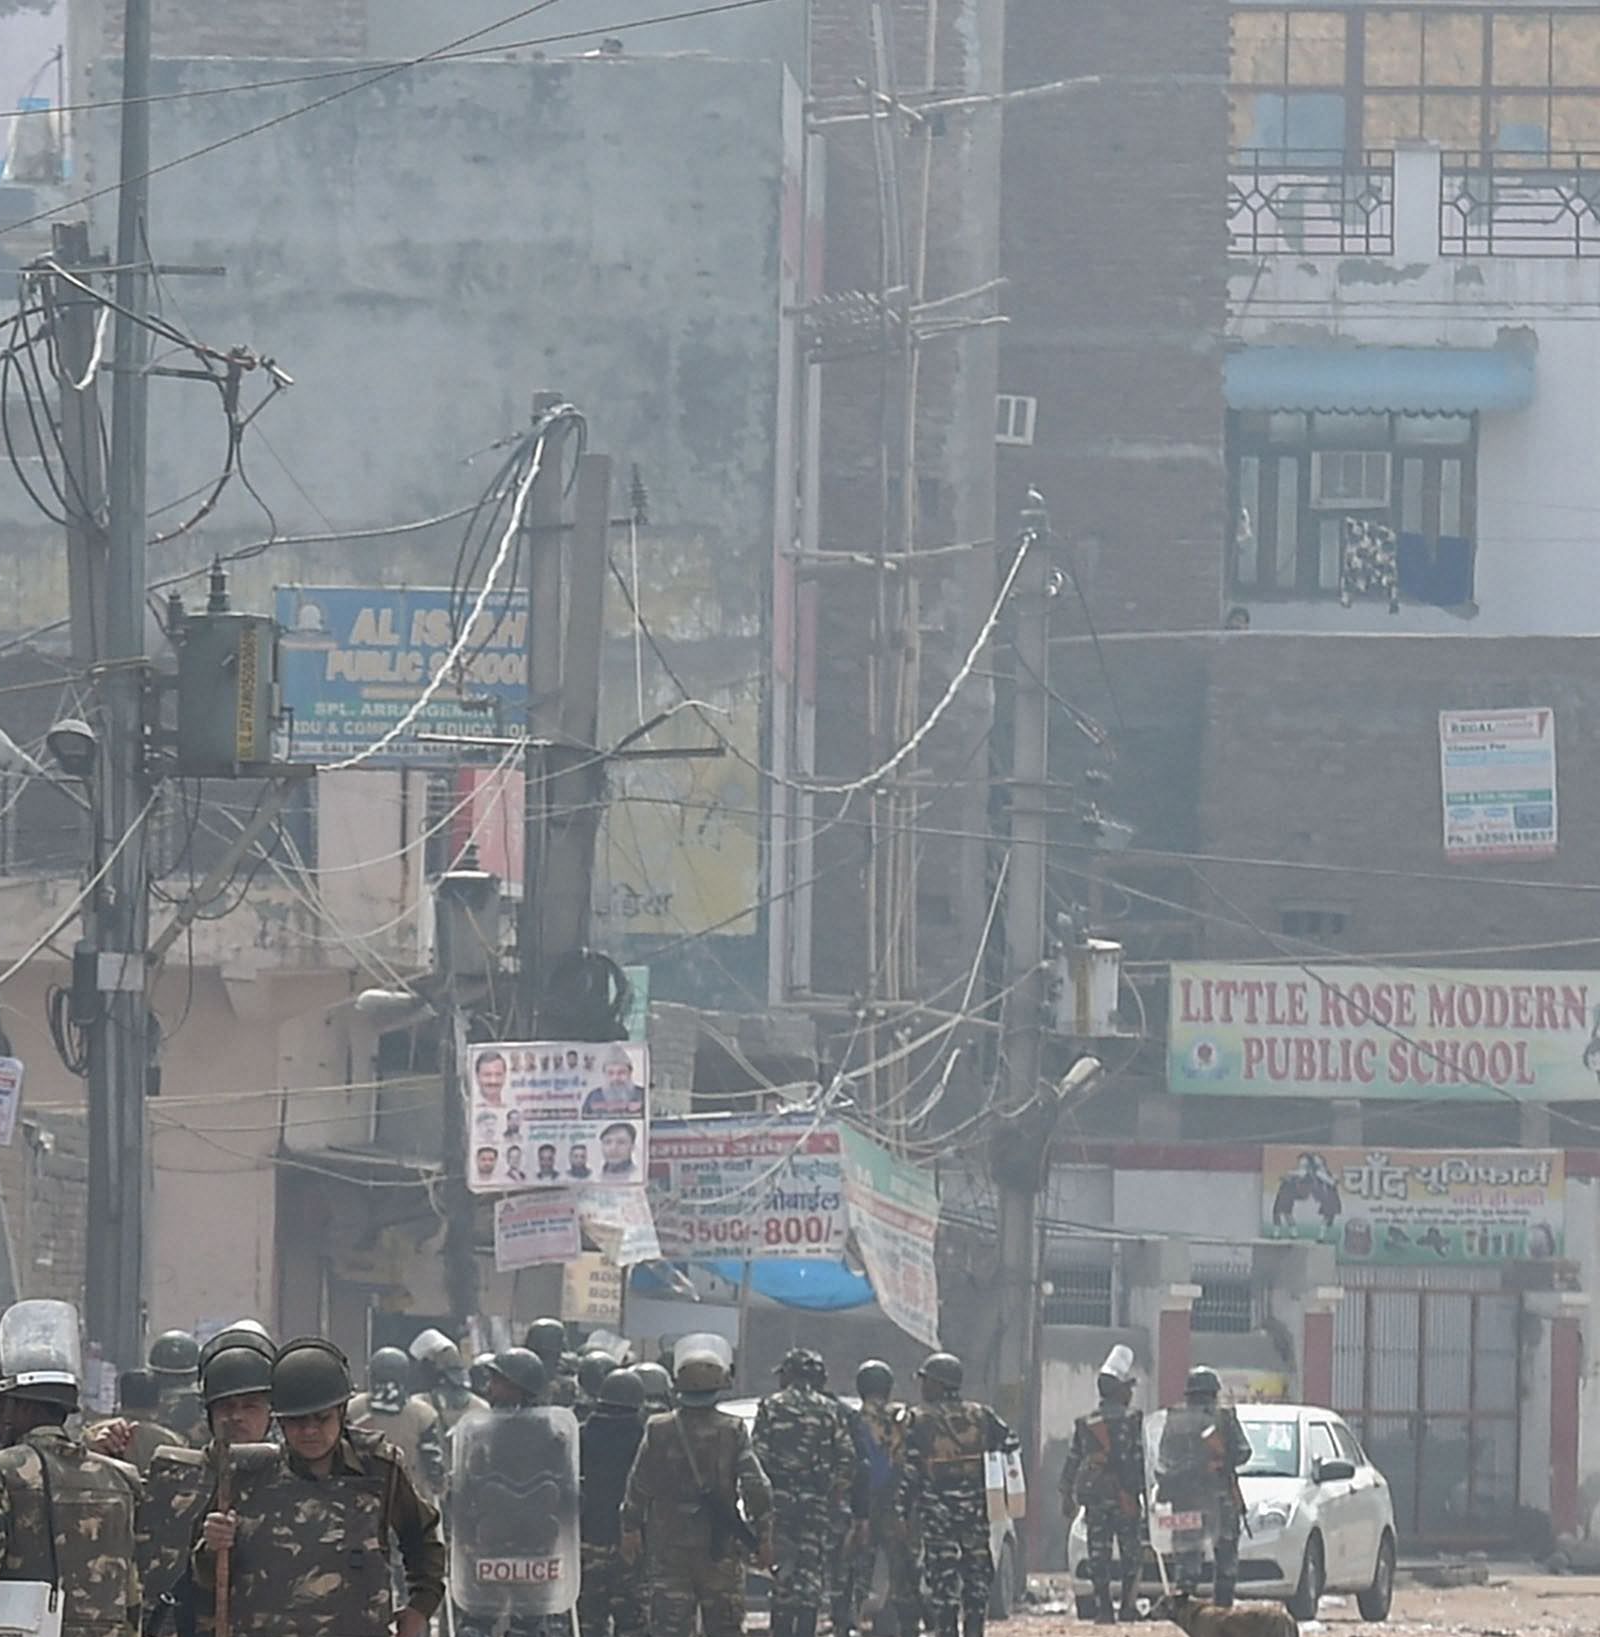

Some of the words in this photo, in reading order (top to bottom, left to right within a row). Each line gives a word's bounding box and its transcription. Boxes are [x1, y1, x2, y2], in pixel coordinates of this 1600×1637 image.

[350, 607, 400, 647] AL
[1180, 978, 1309, 1026] LITTLE
[1318, 981, 1418, 1027] ROSE
[1427, 983, 1588, 1030] MODERN
[1242, 1036, 1378, 1083] PUBLIC
[1388, 1039, 1536, 1086] SCHOOL
[764, 1216, 844, 1245] 800/-
[479, 1560, 560, 1580] POLICE
